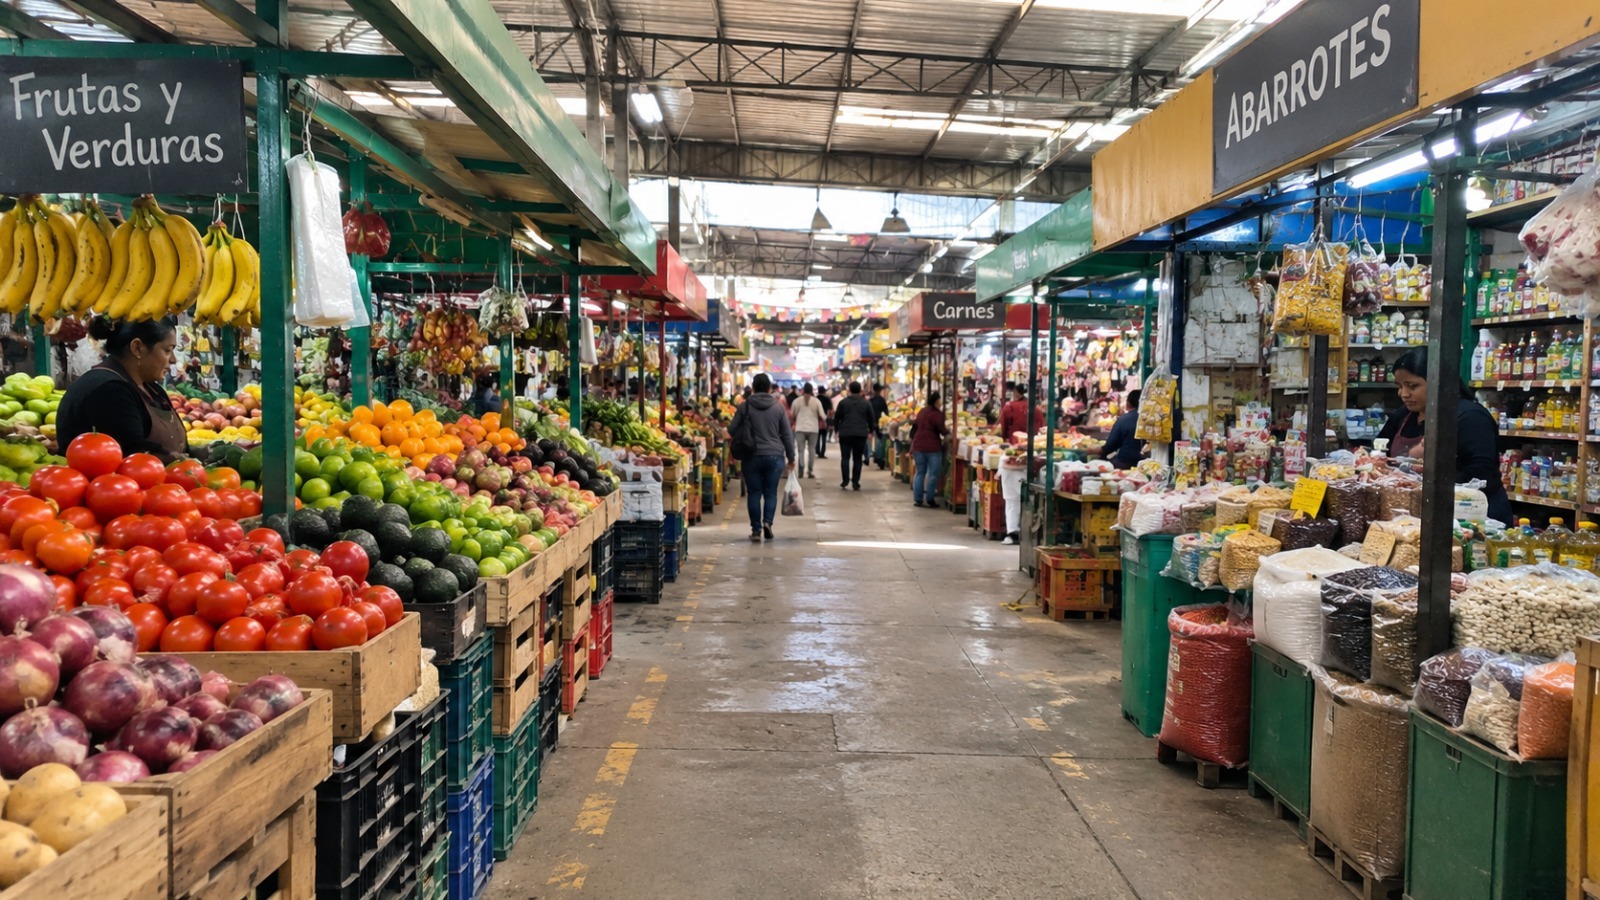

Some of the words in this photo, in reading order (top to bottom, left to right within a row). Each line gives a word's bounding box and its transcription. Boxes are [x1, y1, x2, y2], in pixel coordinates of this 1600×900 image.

[8, 72, 142, 121] Frutas
[159, 81, 183, 125] y
[1224, 3, 1392, 150] ABARROTES
[41, 122, 225, 171] Verduras
[933, 301, 995, 319] Carnes
